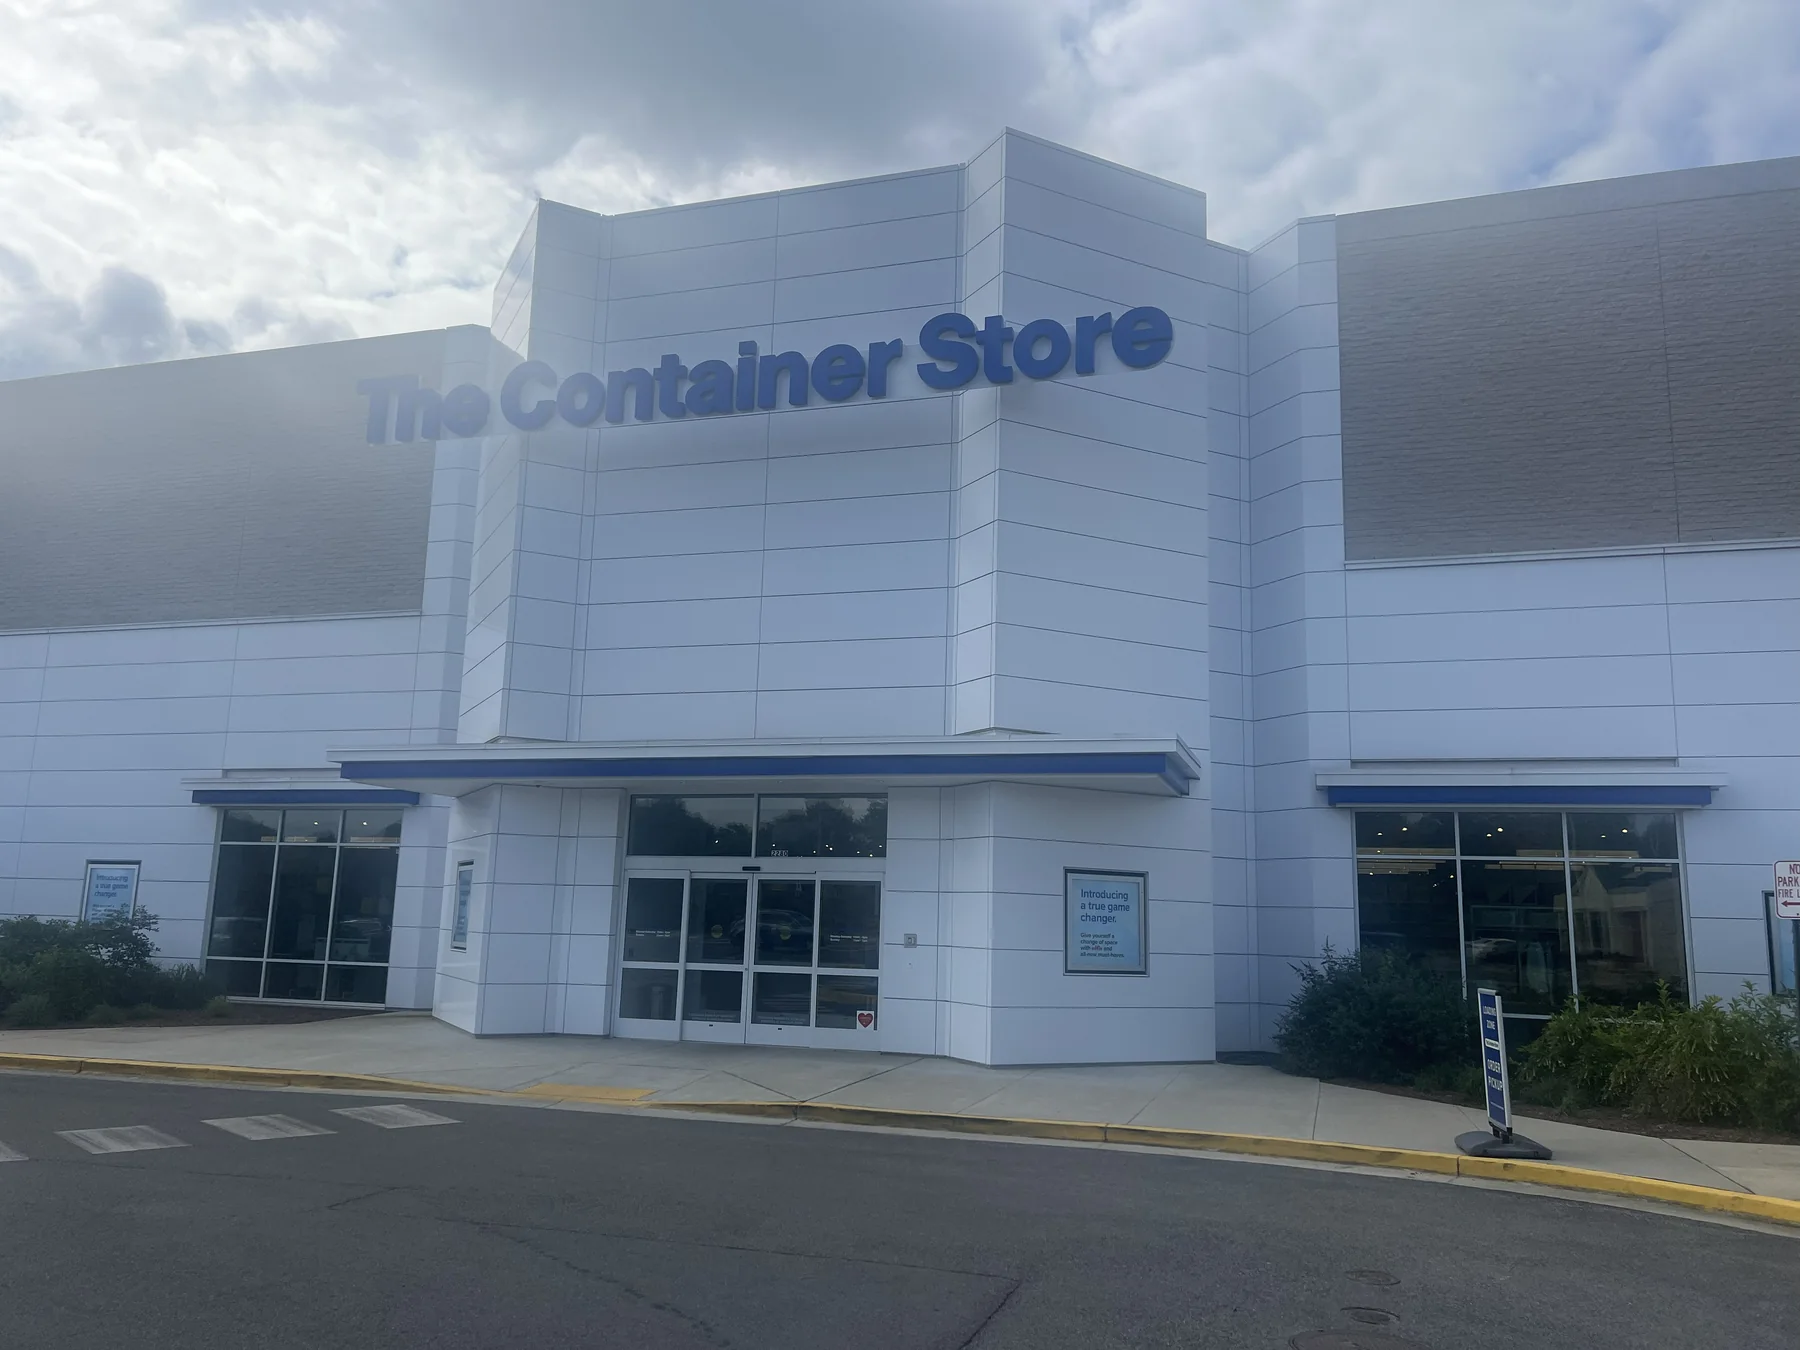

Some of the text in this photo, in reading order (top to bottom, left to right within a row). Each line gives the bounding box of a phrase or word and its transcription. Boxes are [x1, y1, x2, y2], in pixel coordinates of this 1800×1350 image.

[356, 306, 1174, 439] The Container Store
[1789, 863, 1800, 875] NO
[1080, 888, 1129, 902] Introducing
[1777, 889, 1794, 898] FIRE
[1080, 902, 1130, 913] a true game
[1080, 913, 1117, 924] changer.
